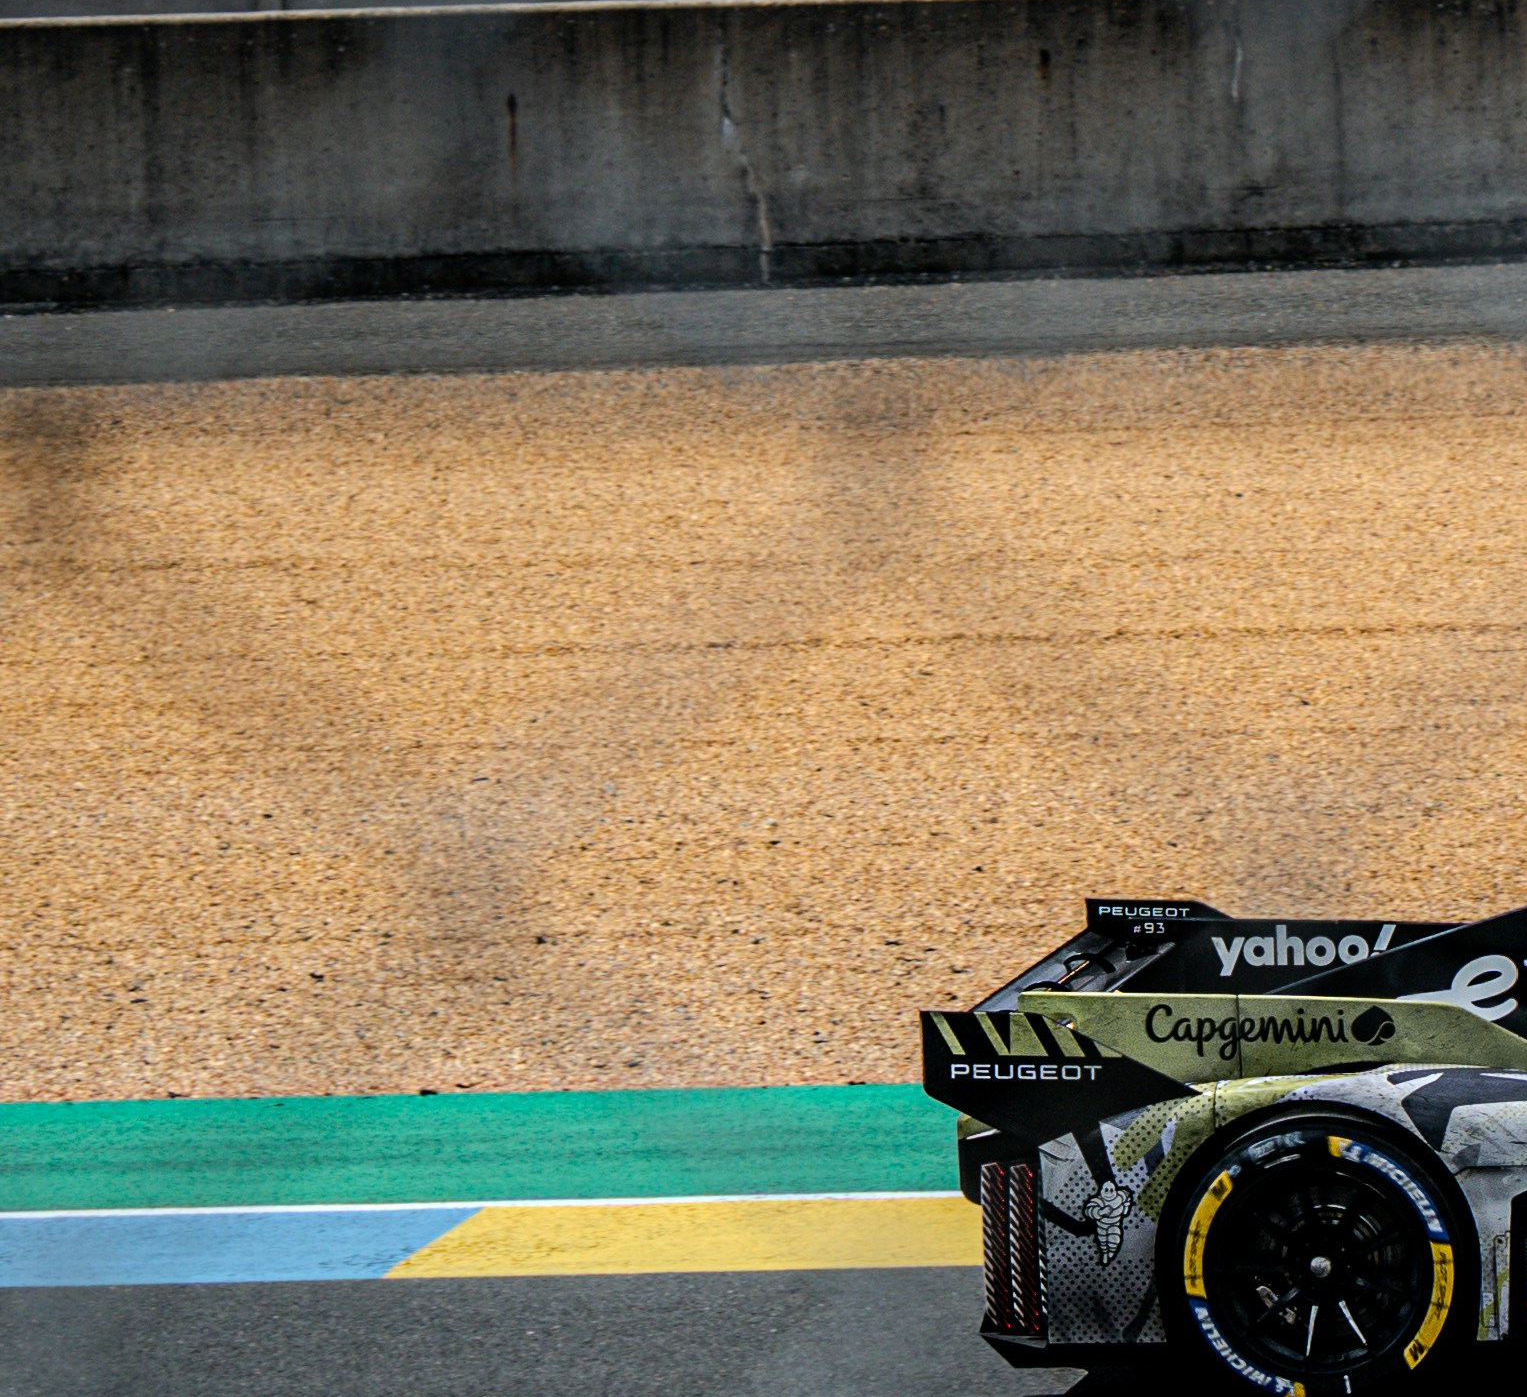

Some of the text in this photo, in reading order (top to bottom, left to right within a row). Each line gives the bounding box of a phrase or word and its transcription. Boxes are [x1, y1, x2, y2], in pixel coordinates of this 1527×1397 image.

[1099, 906, 1190, 917] PEUGEOT
[1133, 922, 1165, 934] #93
[1211, 924, 1397, 977] yahoo!
[1146, 1004, 1349, 1061] Capgemini
[950, 1064, 1102, 1080] PEUGEOT
[1362, 1146, 1444, 1236] MICHELIN
[1192, 1304, 1271, 1389] MICHELIN
